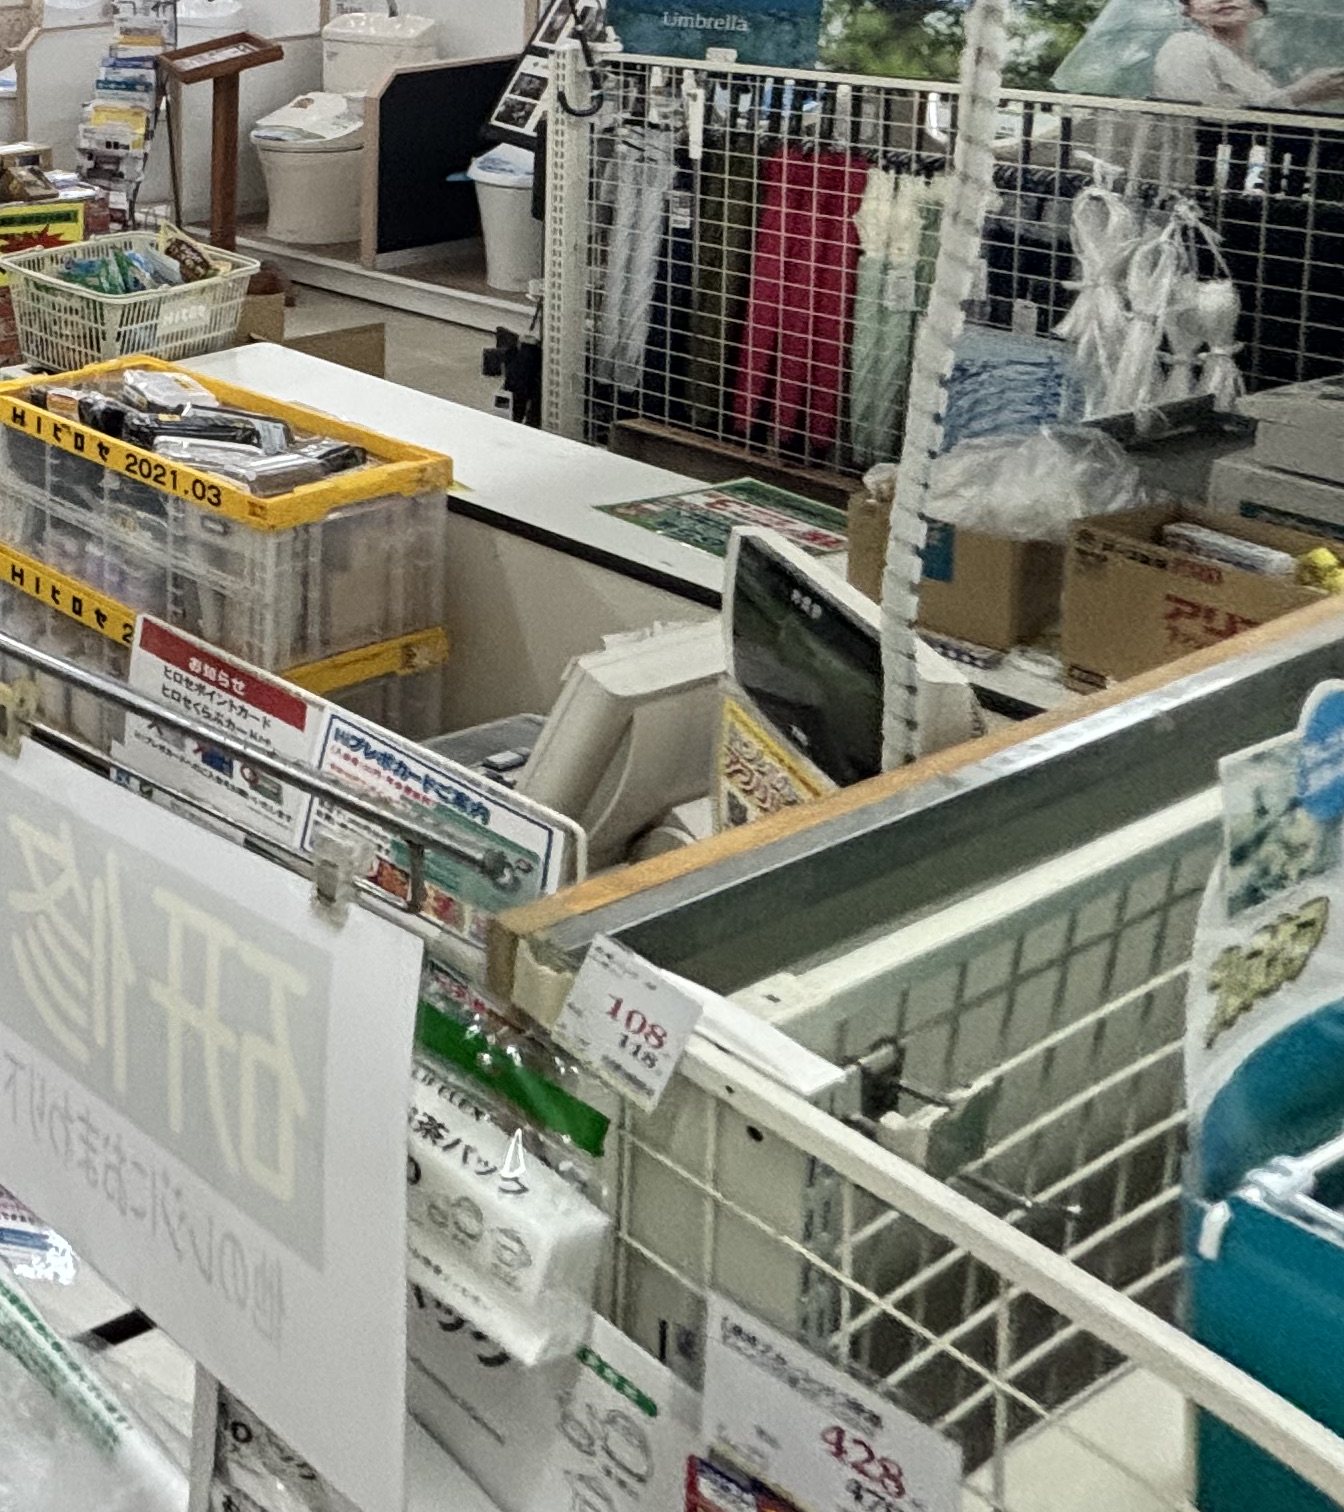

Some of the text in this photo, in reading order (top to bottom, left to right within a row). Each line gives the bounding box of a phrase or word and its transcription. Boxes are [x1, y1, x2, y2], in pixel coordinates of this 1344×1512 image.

[662, 11, 749, 33] Umbrella
[124, 452, 223, 508] 2021.03
[188, 656, 246, 696] お知らせ
[607, 993, 668, 1050] 108
